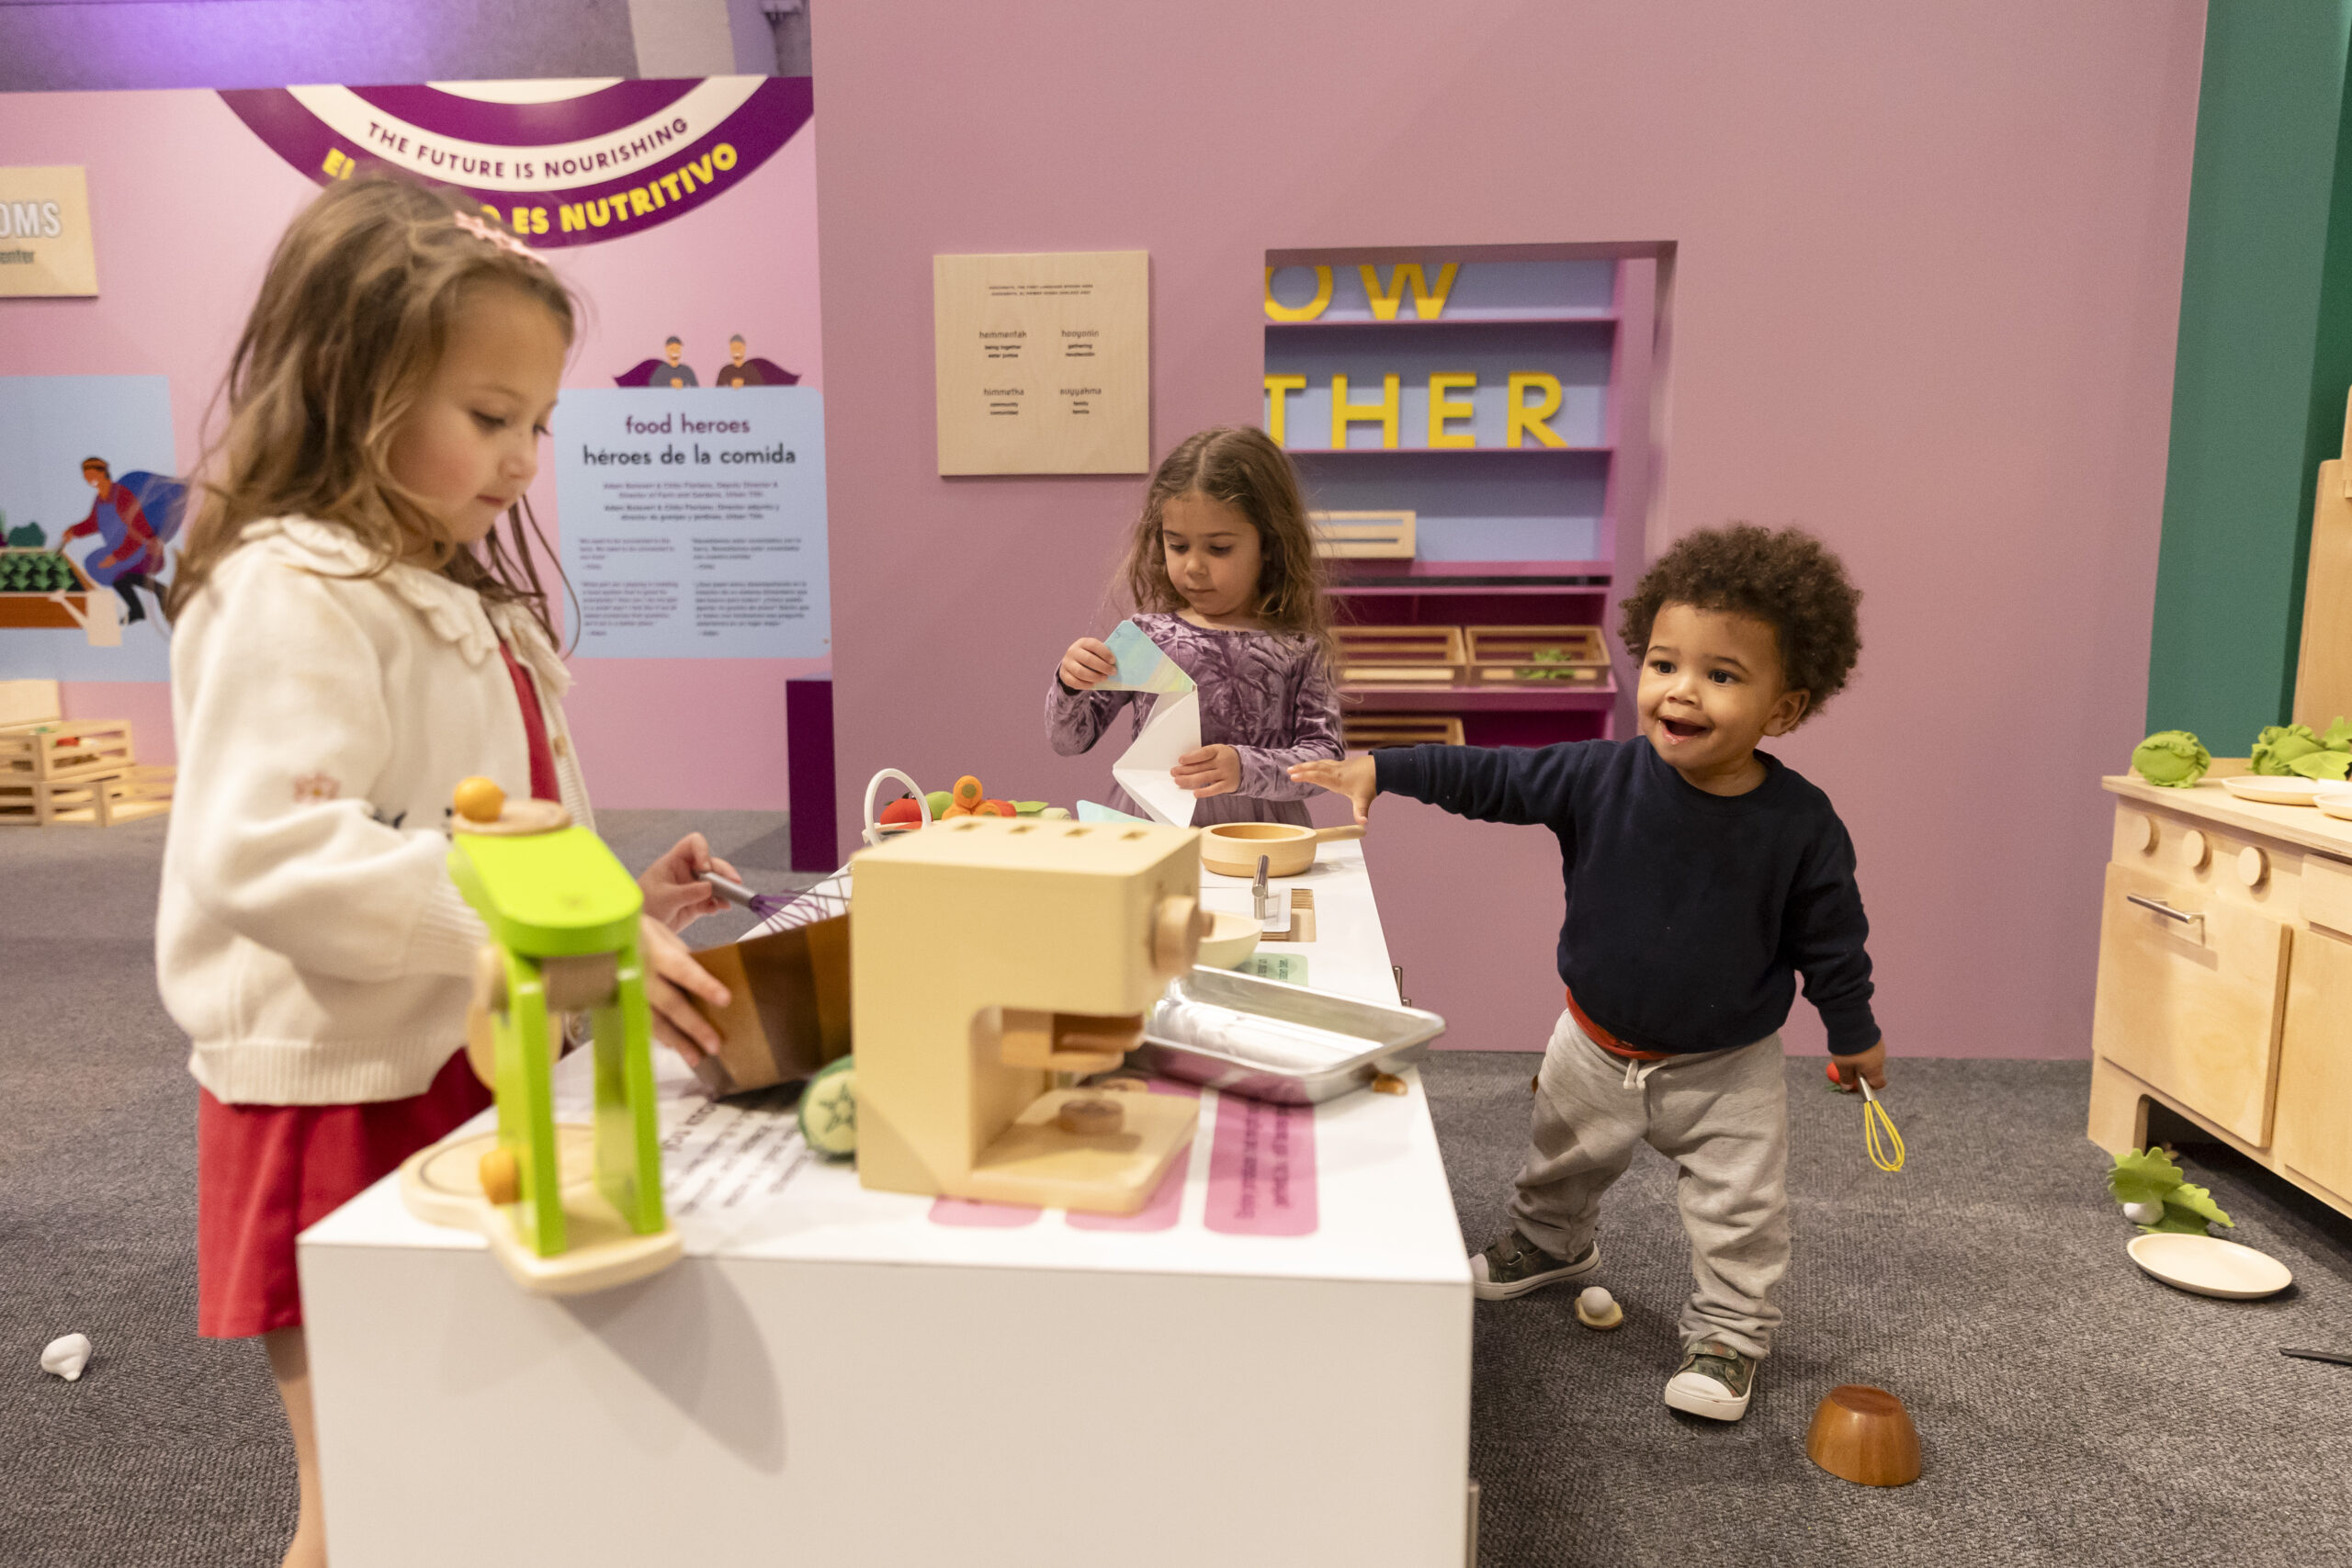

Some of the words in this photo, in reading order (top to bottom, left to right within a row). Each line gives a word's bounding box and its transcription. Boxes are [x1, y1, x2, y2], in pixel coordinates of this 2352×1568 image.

[369, 122, 409, 153] THE
[417, 145, 504, 177] FUTURE
[515, 163, 534, 178] IS
[545, 118, 687, 177] NOURISHING
[512, 207, 549, 234] ES
[560, 142, 738, 232] NUTRITIVO
[1264, 263, 1459, 321] OW
[626, 412, 672, 434] food
[681, 412, 751, 434] heroes
[1264, 371, 1568, 448] THER
[582, 444, 651, 465] héroes
[660, 444, 685, 464] de
[695, 444, 711, 464] la
[719, 443, 797, 464] comida
